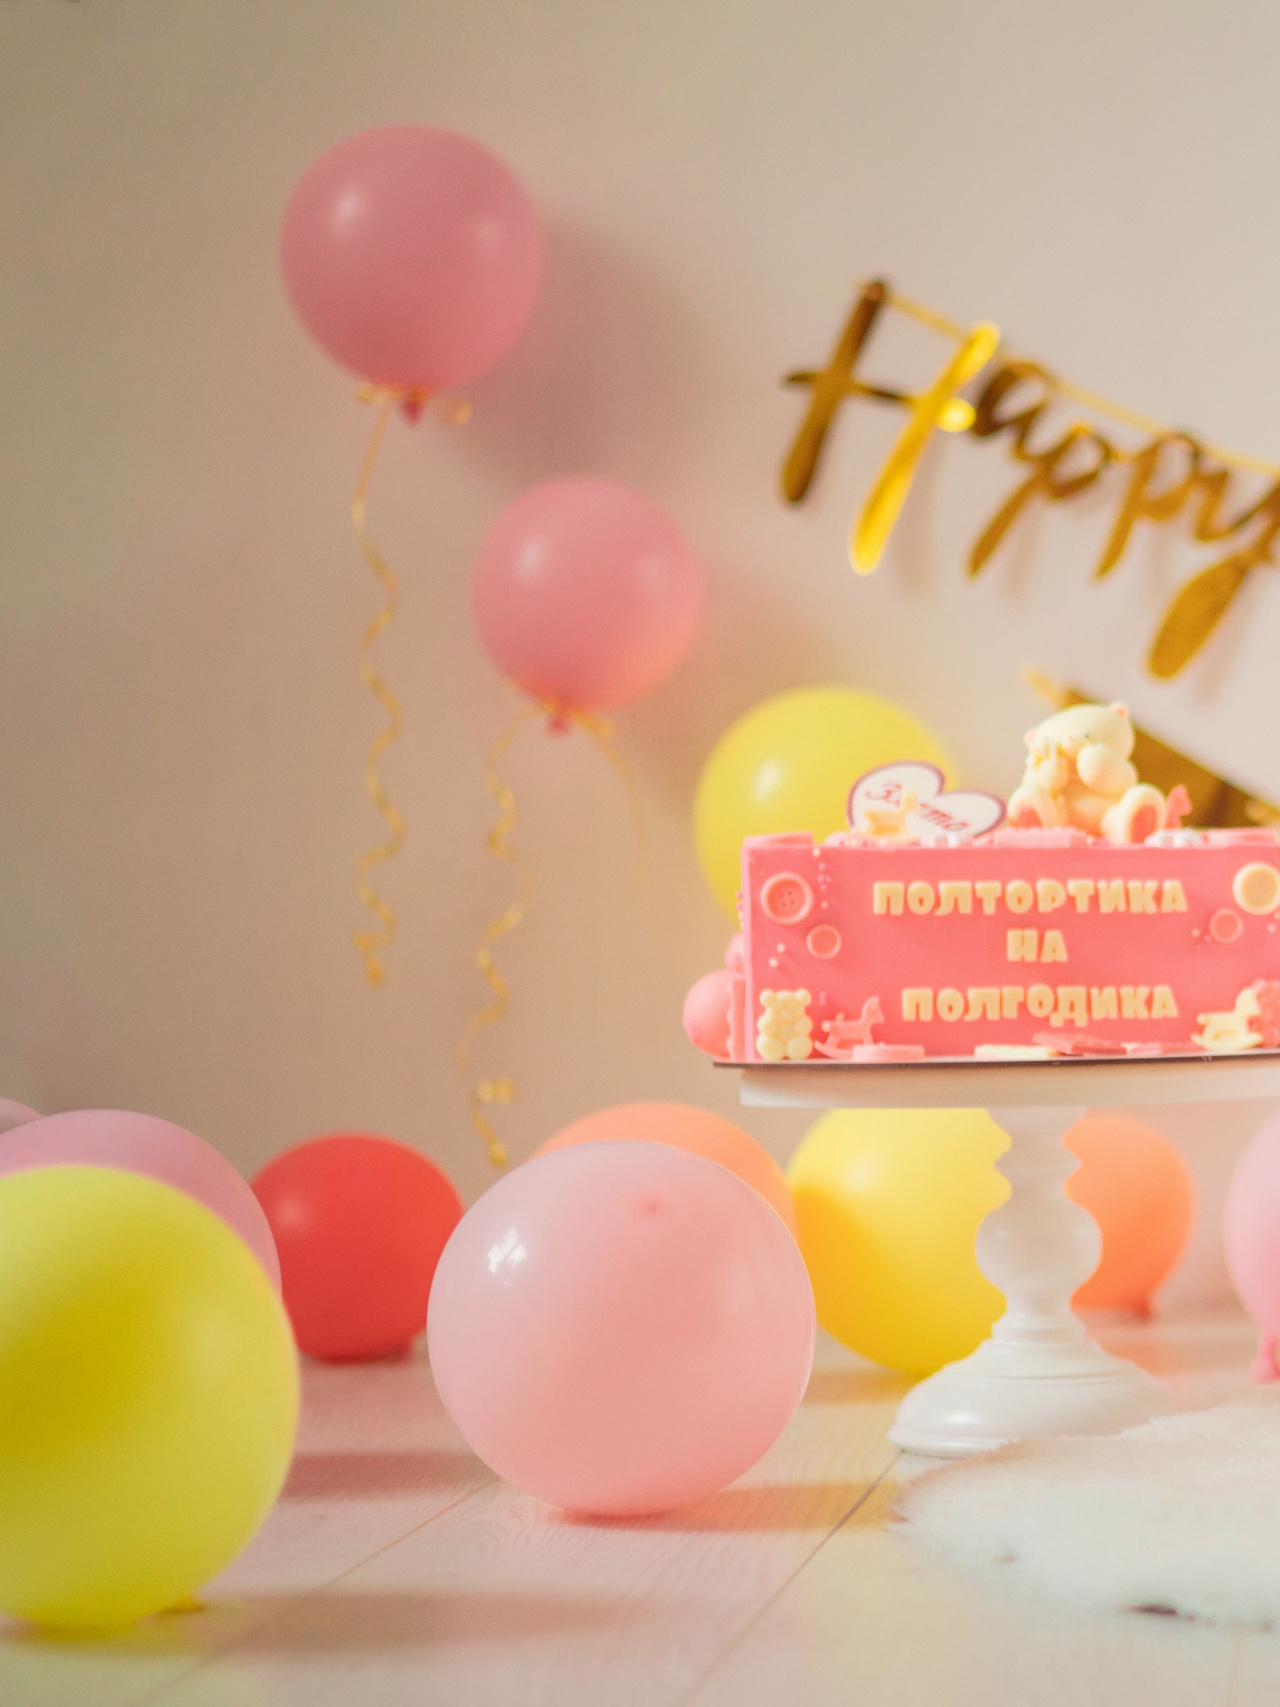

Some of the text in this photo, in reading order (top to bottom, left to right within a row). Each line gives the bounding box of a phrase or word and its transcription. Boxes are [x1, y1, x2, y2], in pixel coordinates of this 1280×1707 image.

[873, 878, 1187, 915] ПОЛТОРТИКА
[1006, 928, 1068, 963] НА
[902, 983, 1179, 1027] ПОЛГОДИКА
